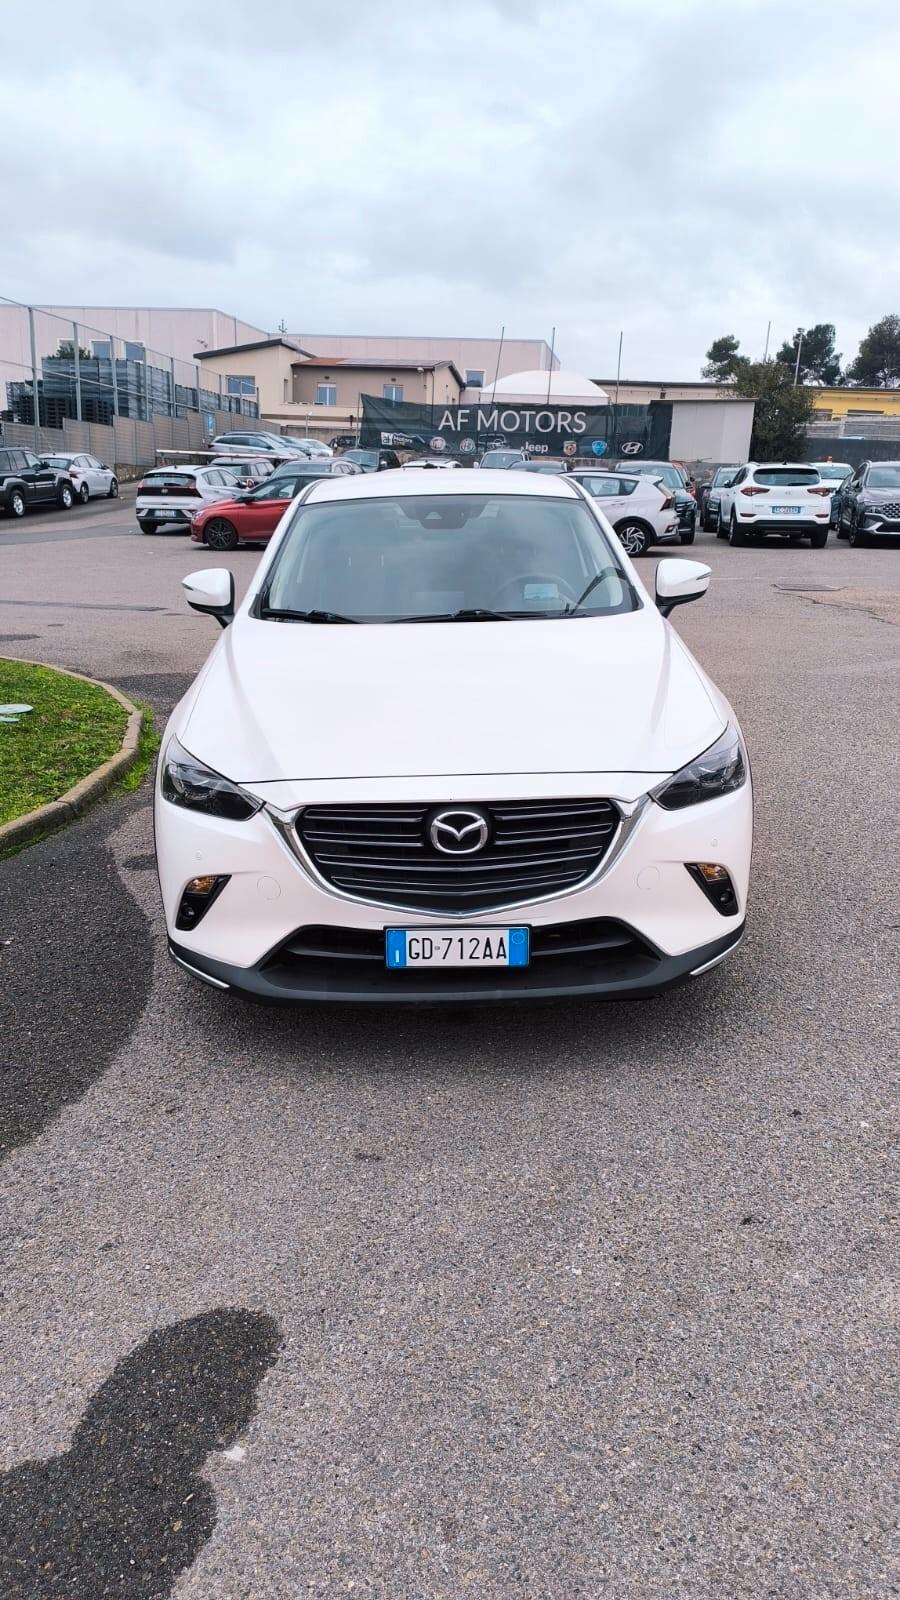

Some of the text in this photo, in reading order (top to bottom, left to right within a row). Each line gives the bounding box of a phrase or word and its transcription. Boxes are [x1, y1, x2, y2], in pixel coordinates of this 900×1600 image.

[438, 409, 587, 433] AF MOTORS
[522, 441, 549, 454] Jeep
